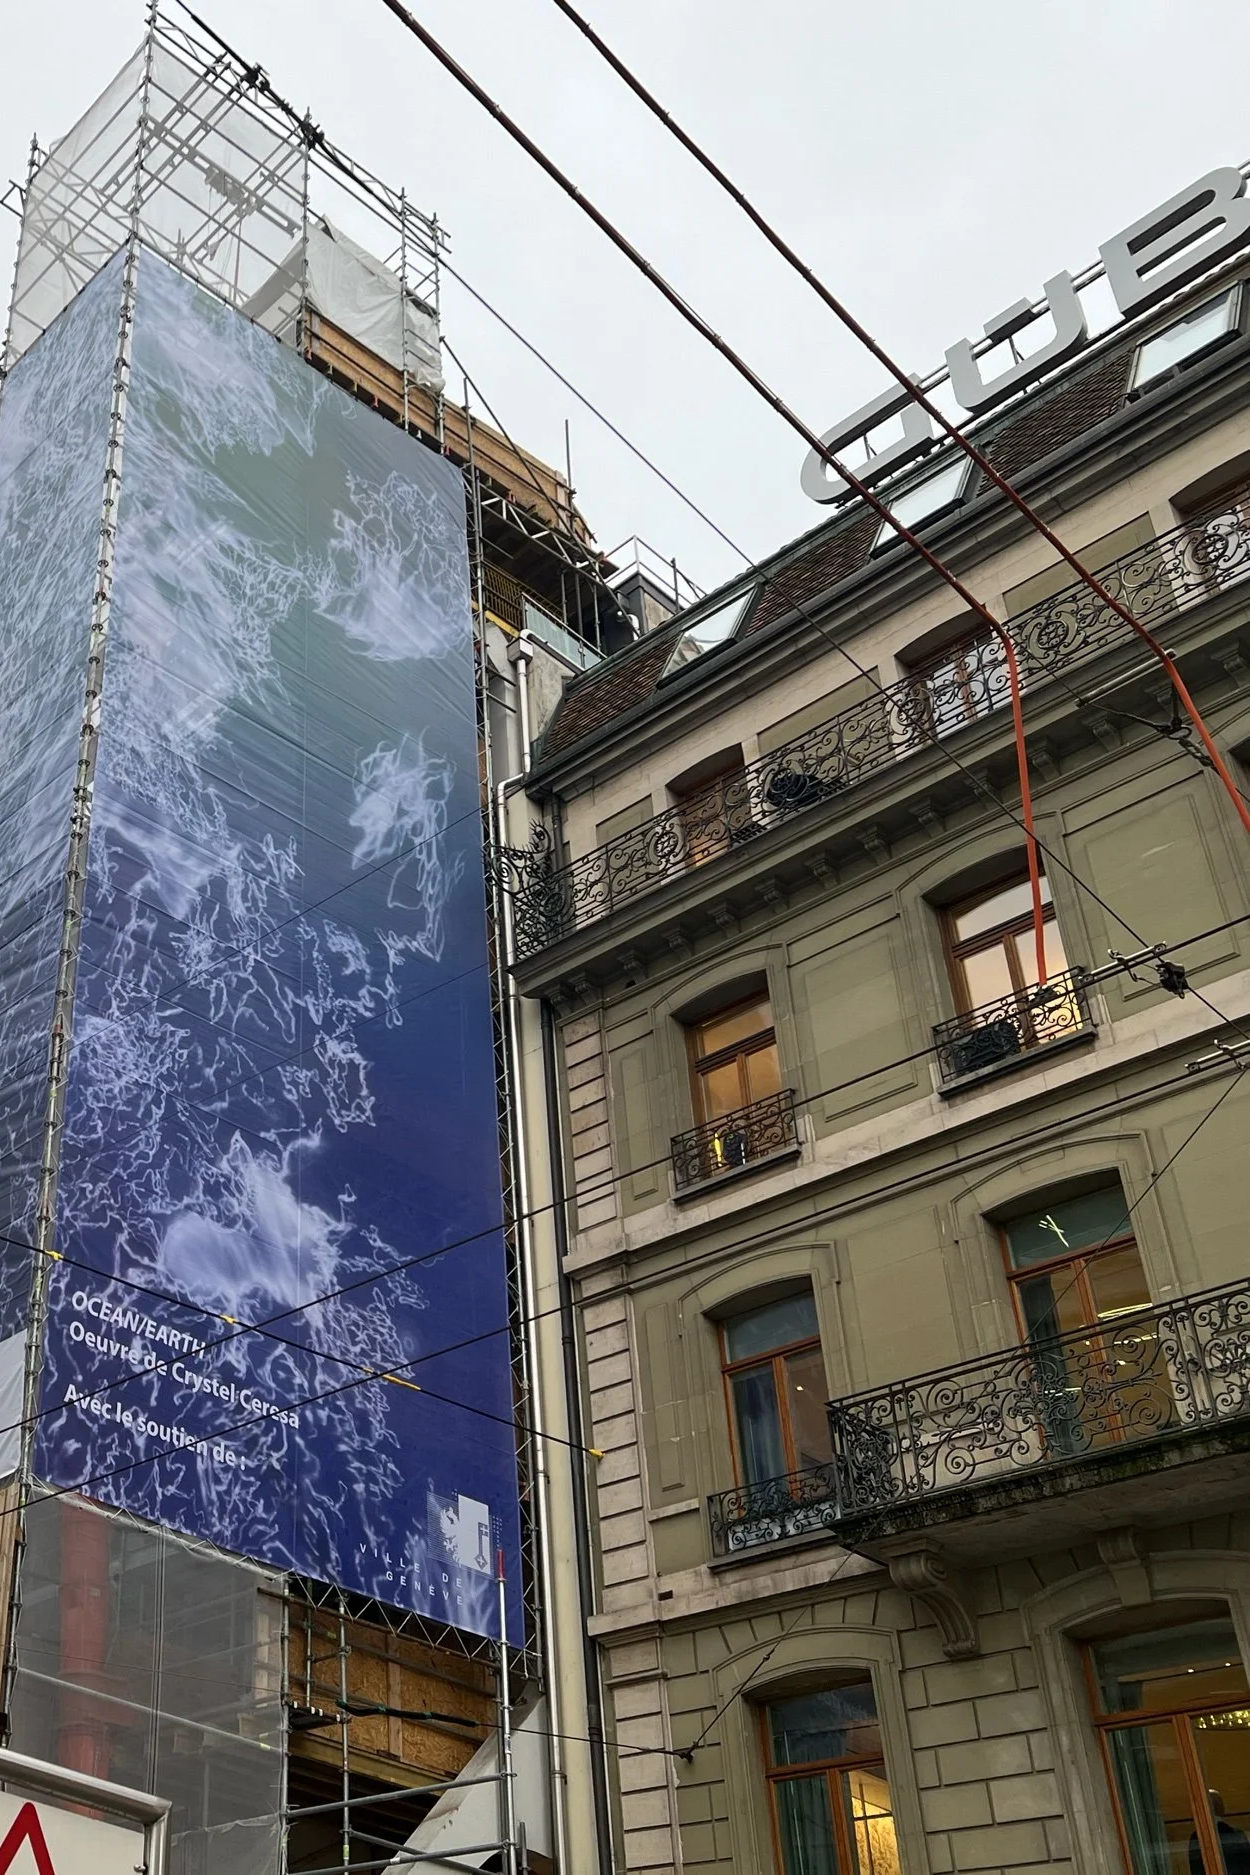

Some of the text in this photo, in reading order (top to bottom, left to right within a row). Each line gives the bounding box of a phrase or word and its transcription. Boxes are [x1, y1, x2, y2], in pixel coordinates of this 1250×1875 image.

[72, 1291, 206, 1359] OCEAN/EARTH
[70, 1321, 299, 1429] Oeuvre de Crystel Ceresa
[64, 1384, 111, 1419] Avec
[116, 1402, 133, 1427] le
[137, 1416, 207, 1456] soutien
[213, 1442, 236, 1467] de
[359, 1543, 462, 1588] VILLE DE
[386, 1570, 463, 1606] GENÈVE
